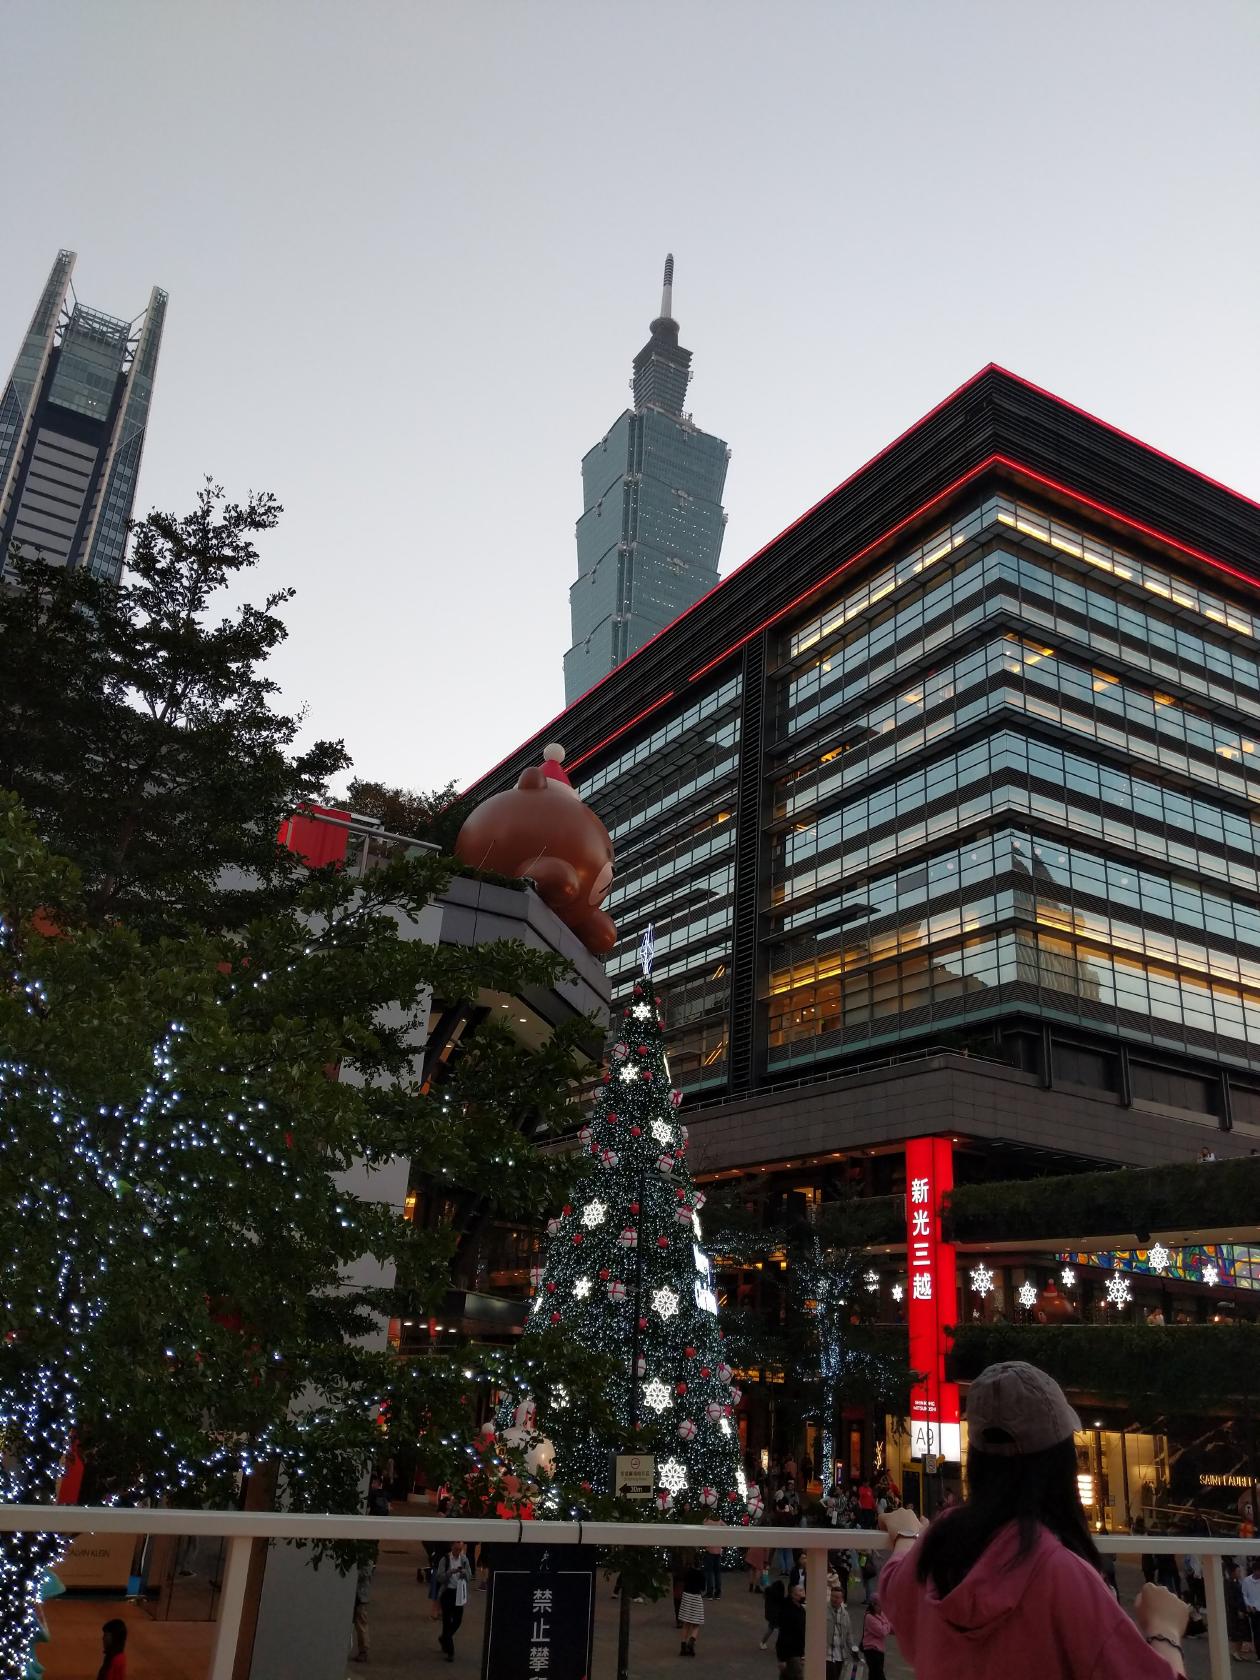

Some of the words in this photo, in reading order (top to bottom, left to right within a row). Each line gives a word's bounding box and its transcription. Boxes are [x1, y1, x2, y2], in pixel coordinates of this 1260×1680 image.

[911, 1177, 932, 1300] 新光三越
[1199, 1474, 1221, 1486] SAINT
[529, 1588, 553, 1680] 禁止攀
